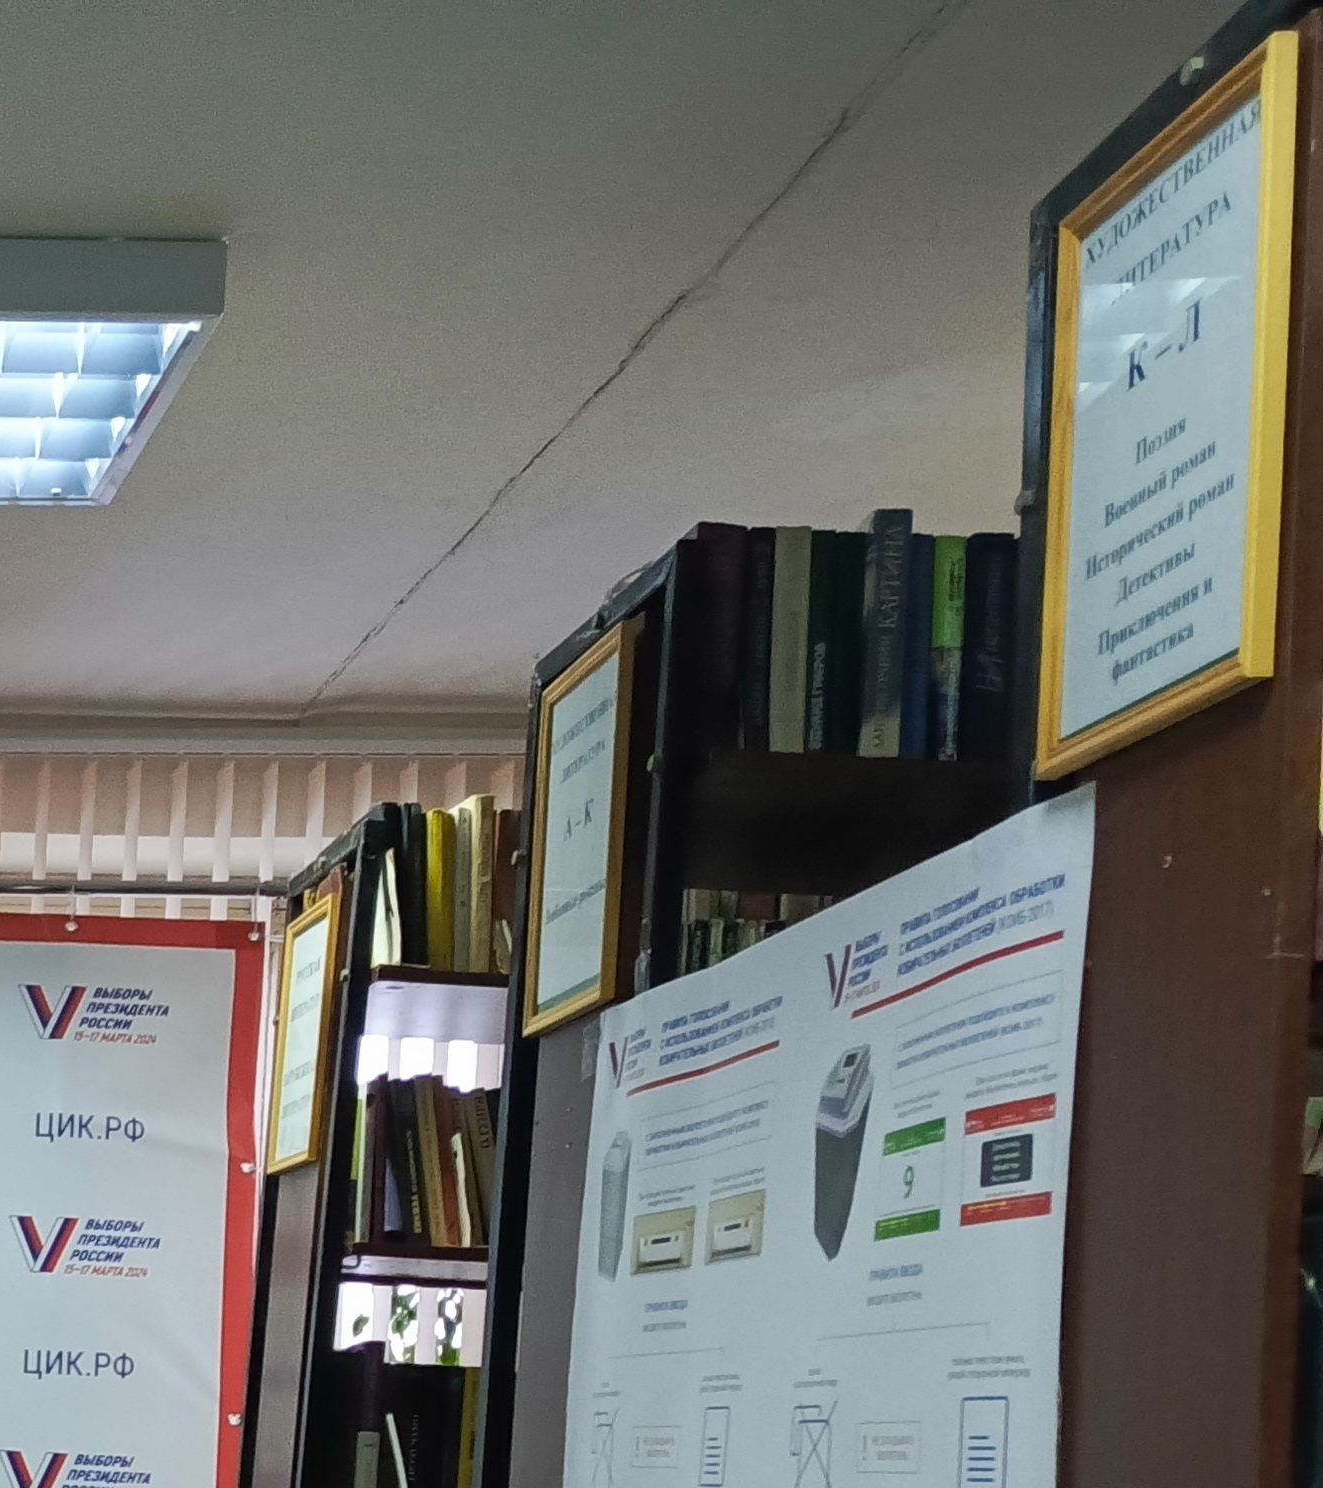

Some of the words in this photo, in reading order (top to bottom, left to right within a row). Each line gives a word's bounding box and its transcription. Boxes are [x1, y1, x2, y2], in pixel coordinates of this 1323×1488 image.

[1085, 95, 1261, 269] ХУДОЖЕСТВЕННАЯ
[1112, 191, 1232, 305] ИТЕРАТУРА
[1104, 469, 1167, 528] Военный
[1171, 440, 1216, 486] роман
[1085, 500, 1184, 581] Исторический
[1188, 472, 1235, 521] роман
[1114, 542, 1196, 605] Детективы
[1098, 583, 1199, 655] Приключения
[1112, 622, 1194, 685] фантастика
[86, 1001, 170, 1017] ПРЕЗИДЕНТА
[93, 987, 153, 1000] ВЫБОРЫ
[79, 1017, 133, 1030] РОССИИ
[35, 1112, 145, 1143] ЦИК.РФ
[85, 1219, 144, 1232] ВЫБОРЫ
[69, 1249, 124, 1262] РОССИИ
[77, 1234, 161, 1249] ПРЕЗИДЕНТА
[23, 1349, 135, 1380] ЦИК.РФ
[74, 1454, 134, 1467] ВЫБОРЫ
[66, 1469, 151, 1484] ПРЕЗИДЕНТА
